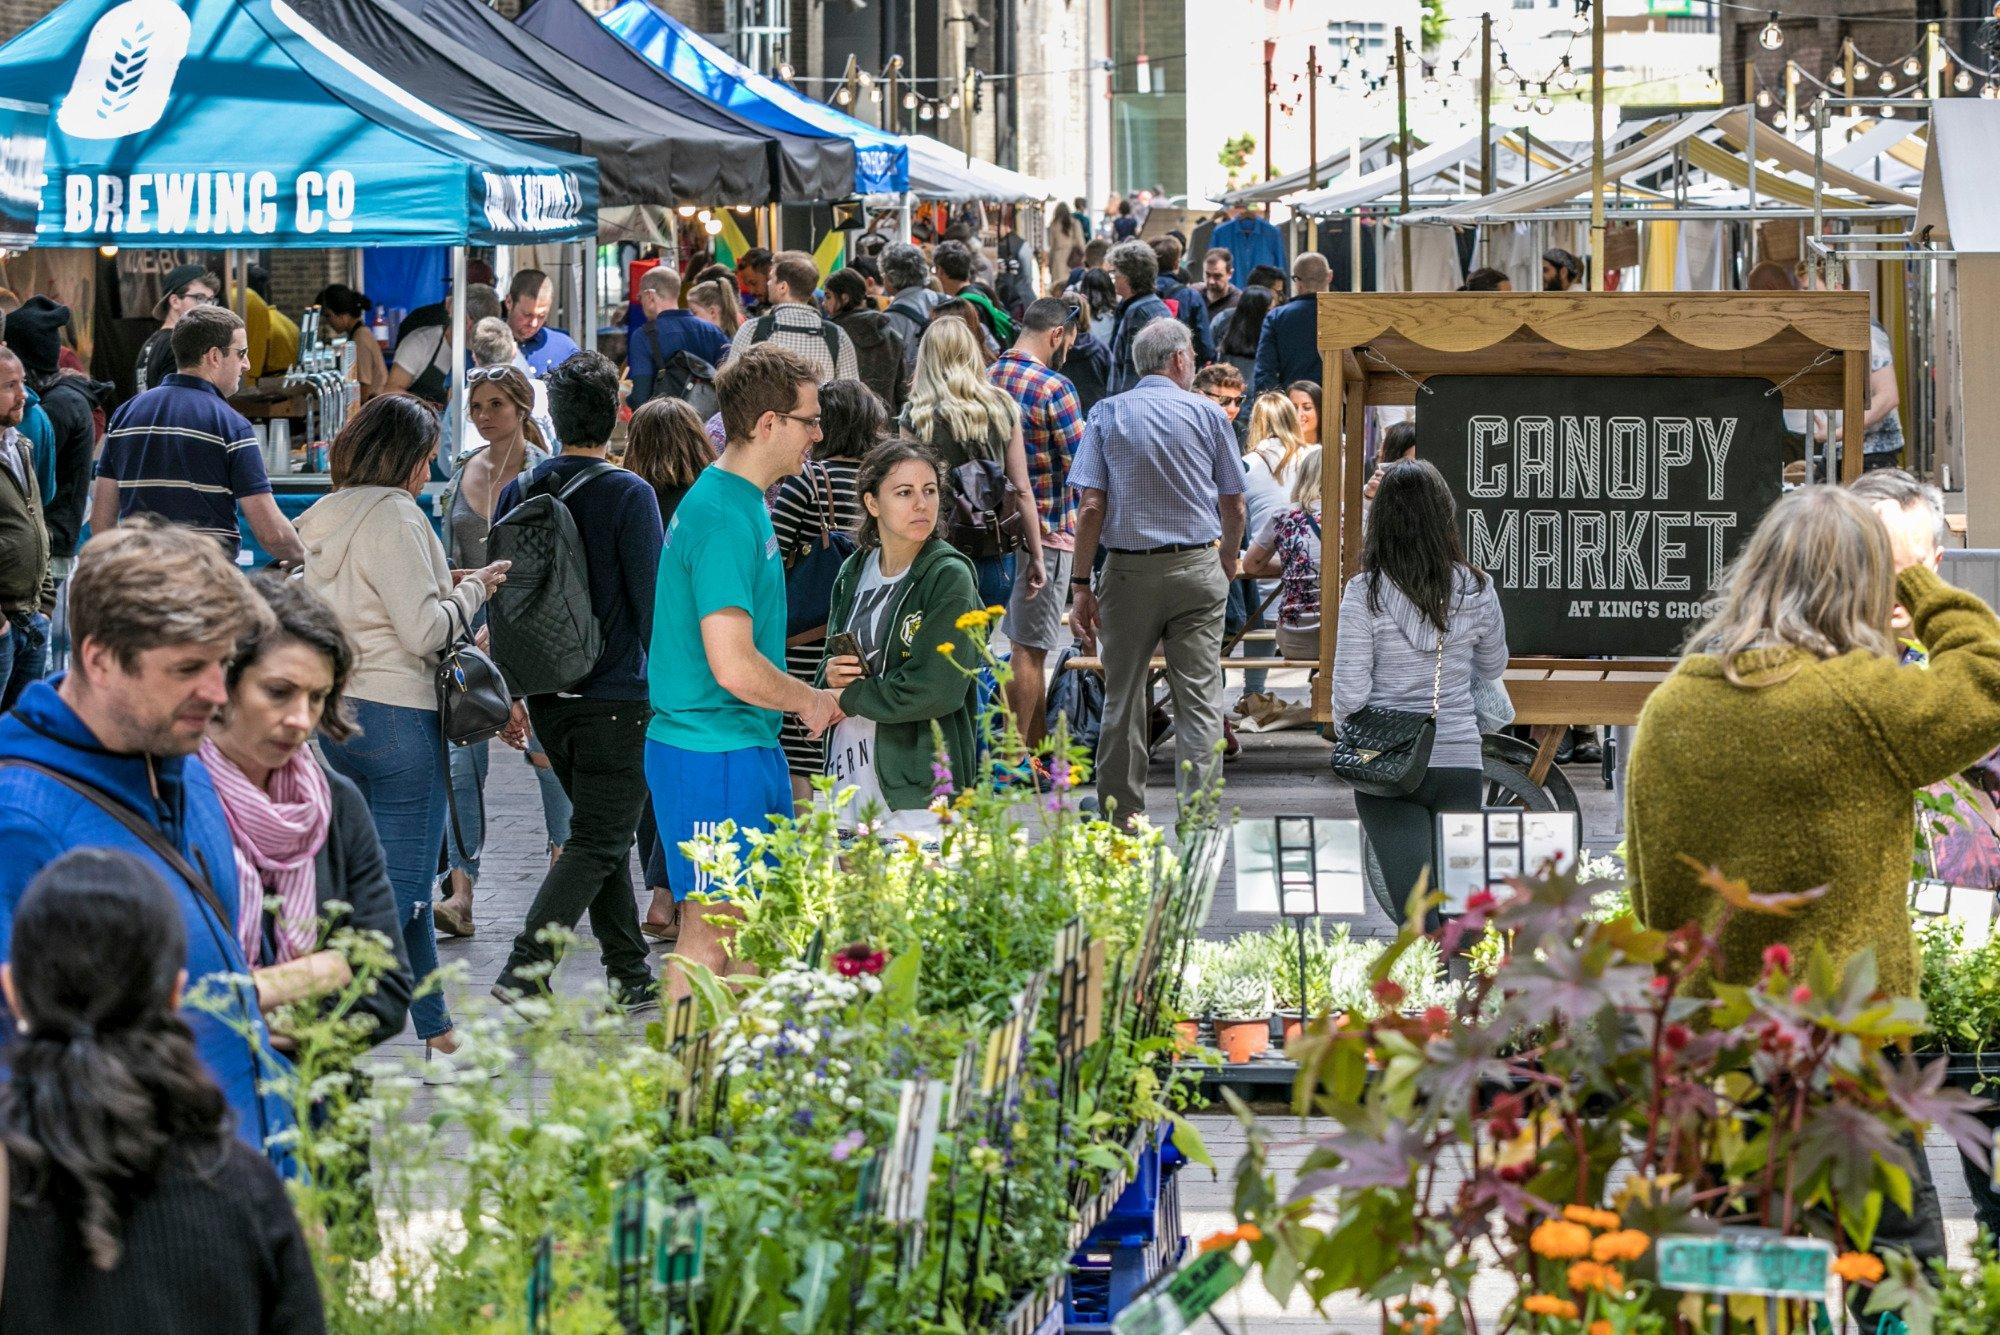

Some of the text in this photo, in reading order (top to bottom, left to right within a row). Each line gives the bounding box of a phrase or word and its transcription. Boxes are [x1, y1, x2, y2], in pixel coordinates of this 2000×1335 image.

[63, 171, 278, 234] BREWING
[296, 169, 356, 234] CO
[1467, 415, 1738, 500] CANOPY
[1466, 508, 1737, 591] MARKET
[1568, 600, 1593, 617] AT
[1598, 600, 1660, 619] KING'S
